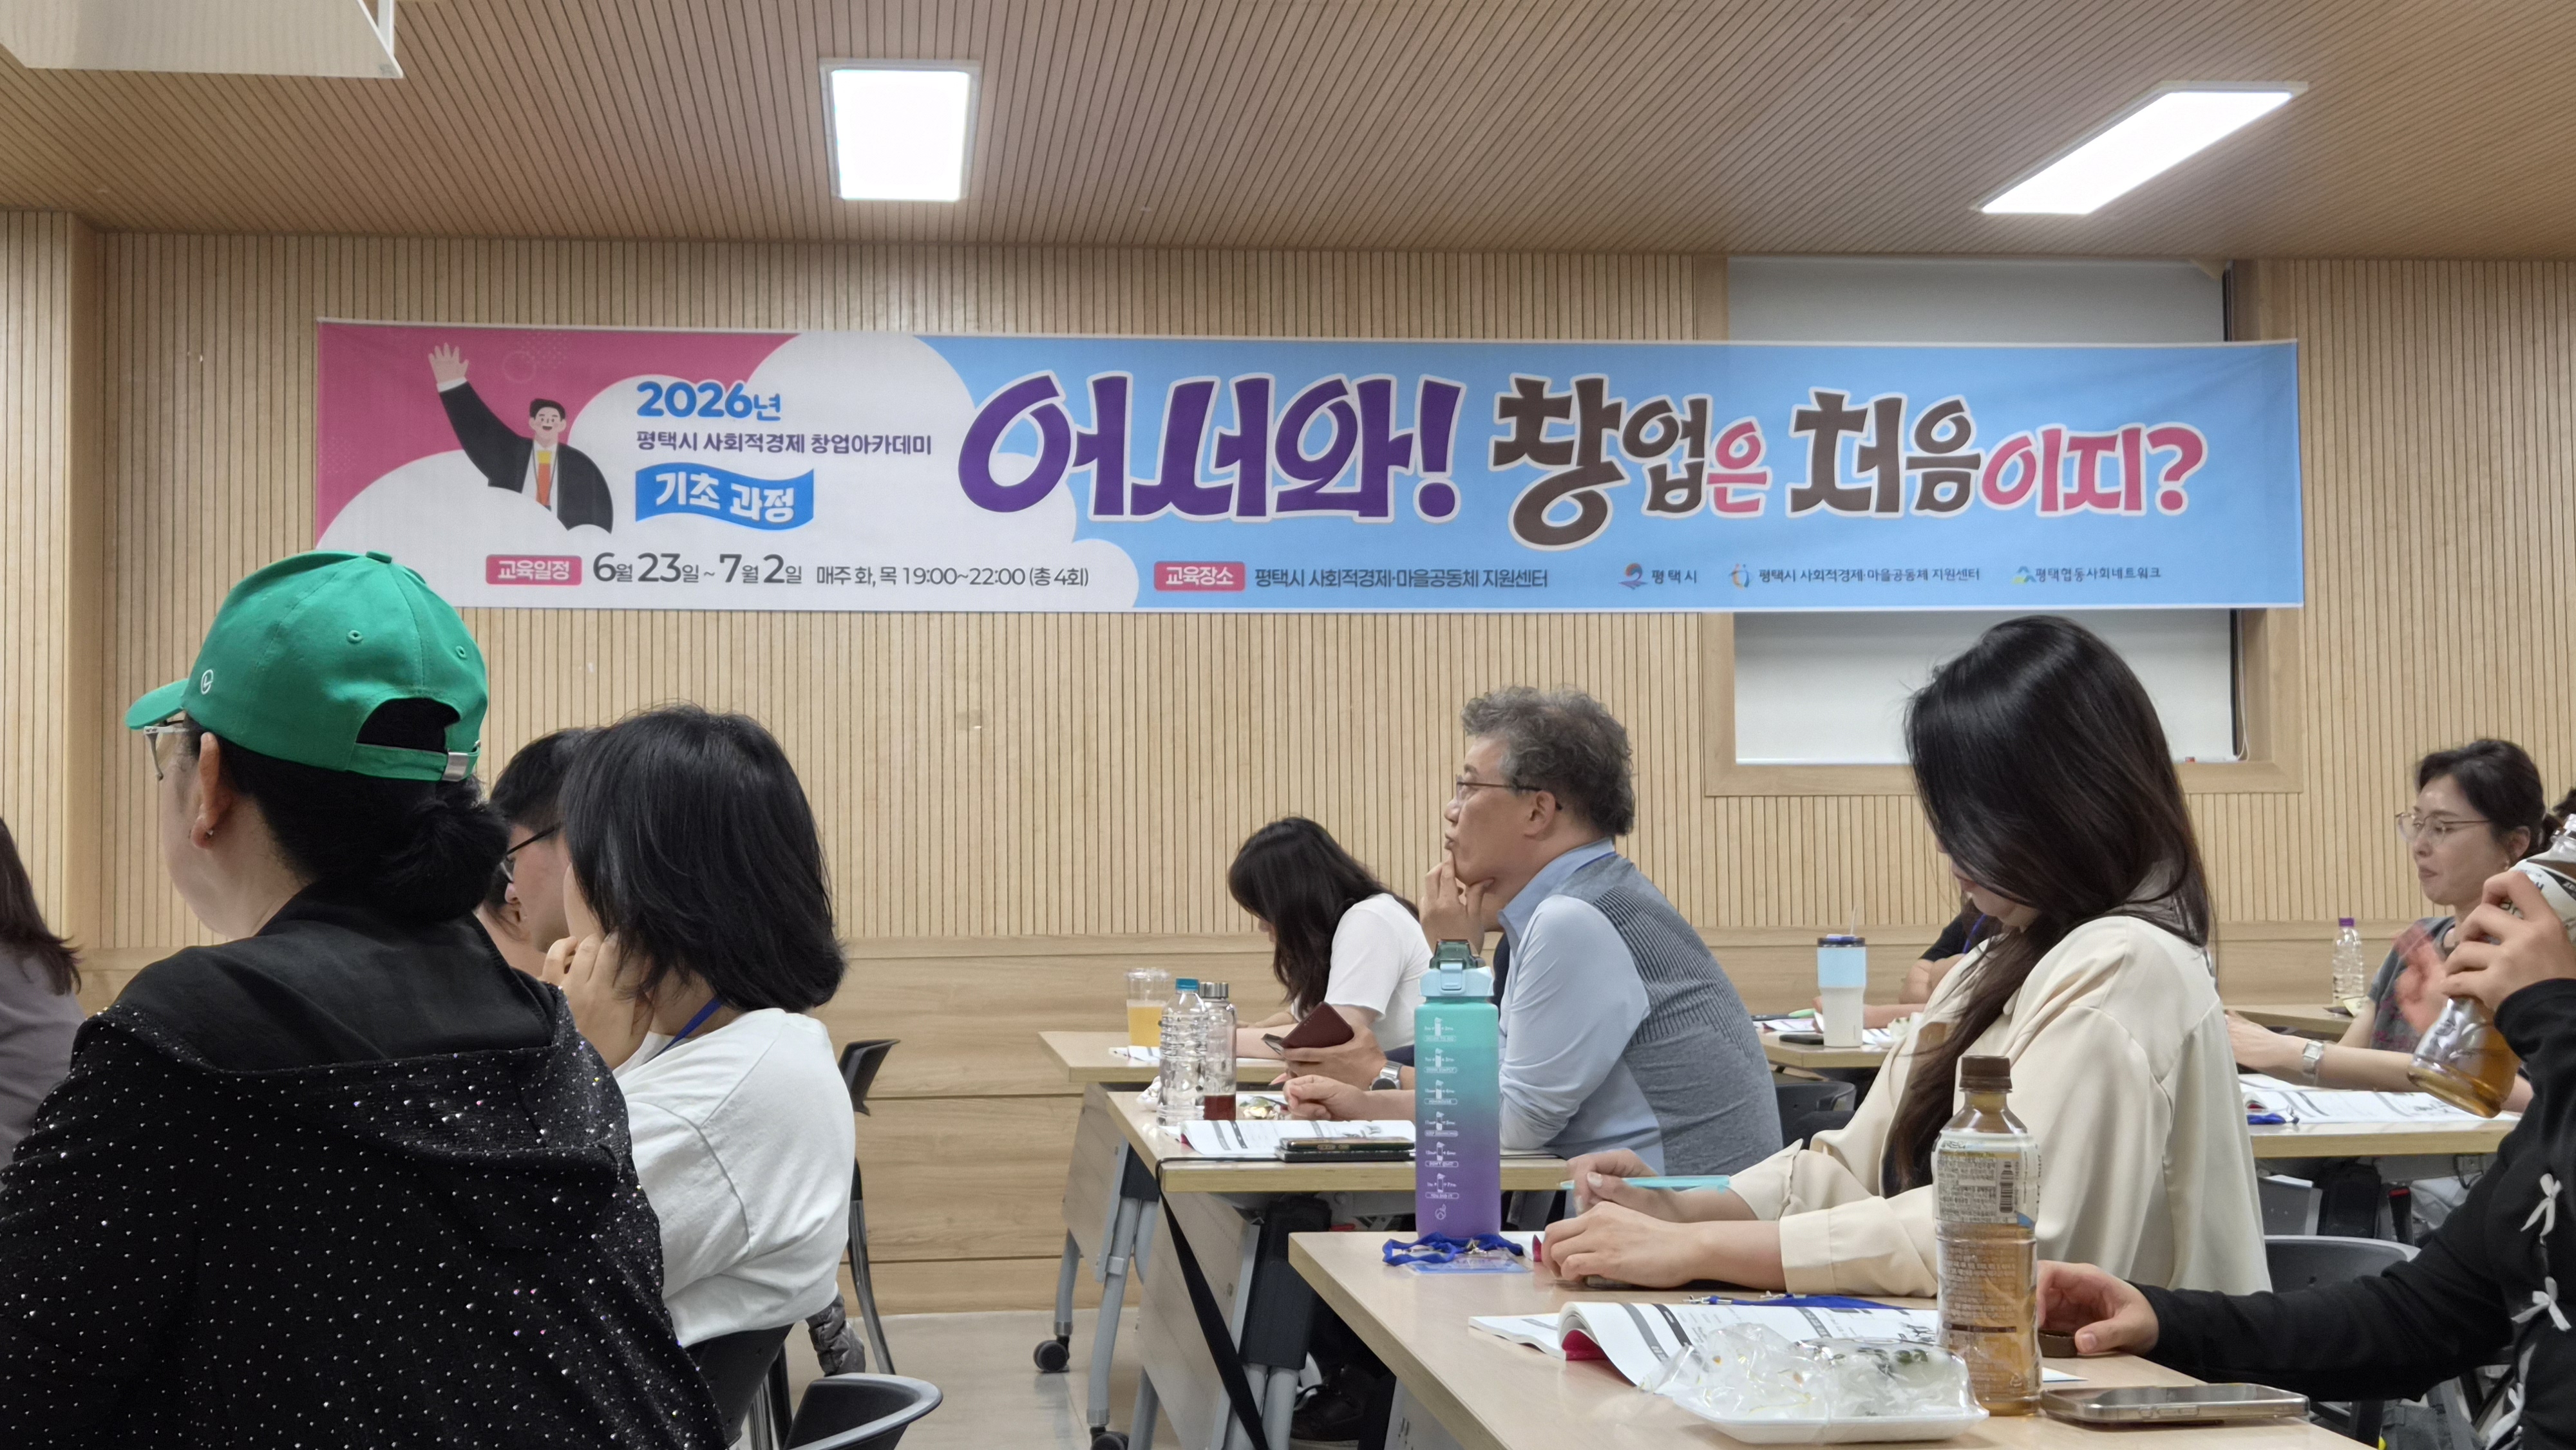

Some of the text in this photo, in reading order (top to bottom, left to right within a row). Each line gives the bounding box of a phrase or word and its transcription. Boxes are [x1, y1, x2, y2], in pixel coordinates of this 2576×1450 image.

[636, 381, 781, 422] 2026년
[636, 431, 932, 455] 평택시 사회적경제 창업아카데미
[958, 373, 2204, 545] 어서와! 창업은 처음이지?
[655, 471, 795, 523] 기초 과정
[497, 559, 570, 581] 교육일정
[816, 565, 852, 586] 매주
[855, 565, 876, 587] 화,
[880, 565, 898, 586] 목
[902, 567, 1026, 586] 19:00~22:00
[1165, 566, 1235, 587] 교육장소
[1255, 569, 1305, 588] 평택시
[1482, 569, 1549, 588] 지원센터
[1651, 569, 1698, 585] 평택시
[1759, 568, 1797, 583] 평택시
[1931, 567, 1980, 581] 지원센터
[2034, 567, 2163, 583] 평택협동사회네트워크
